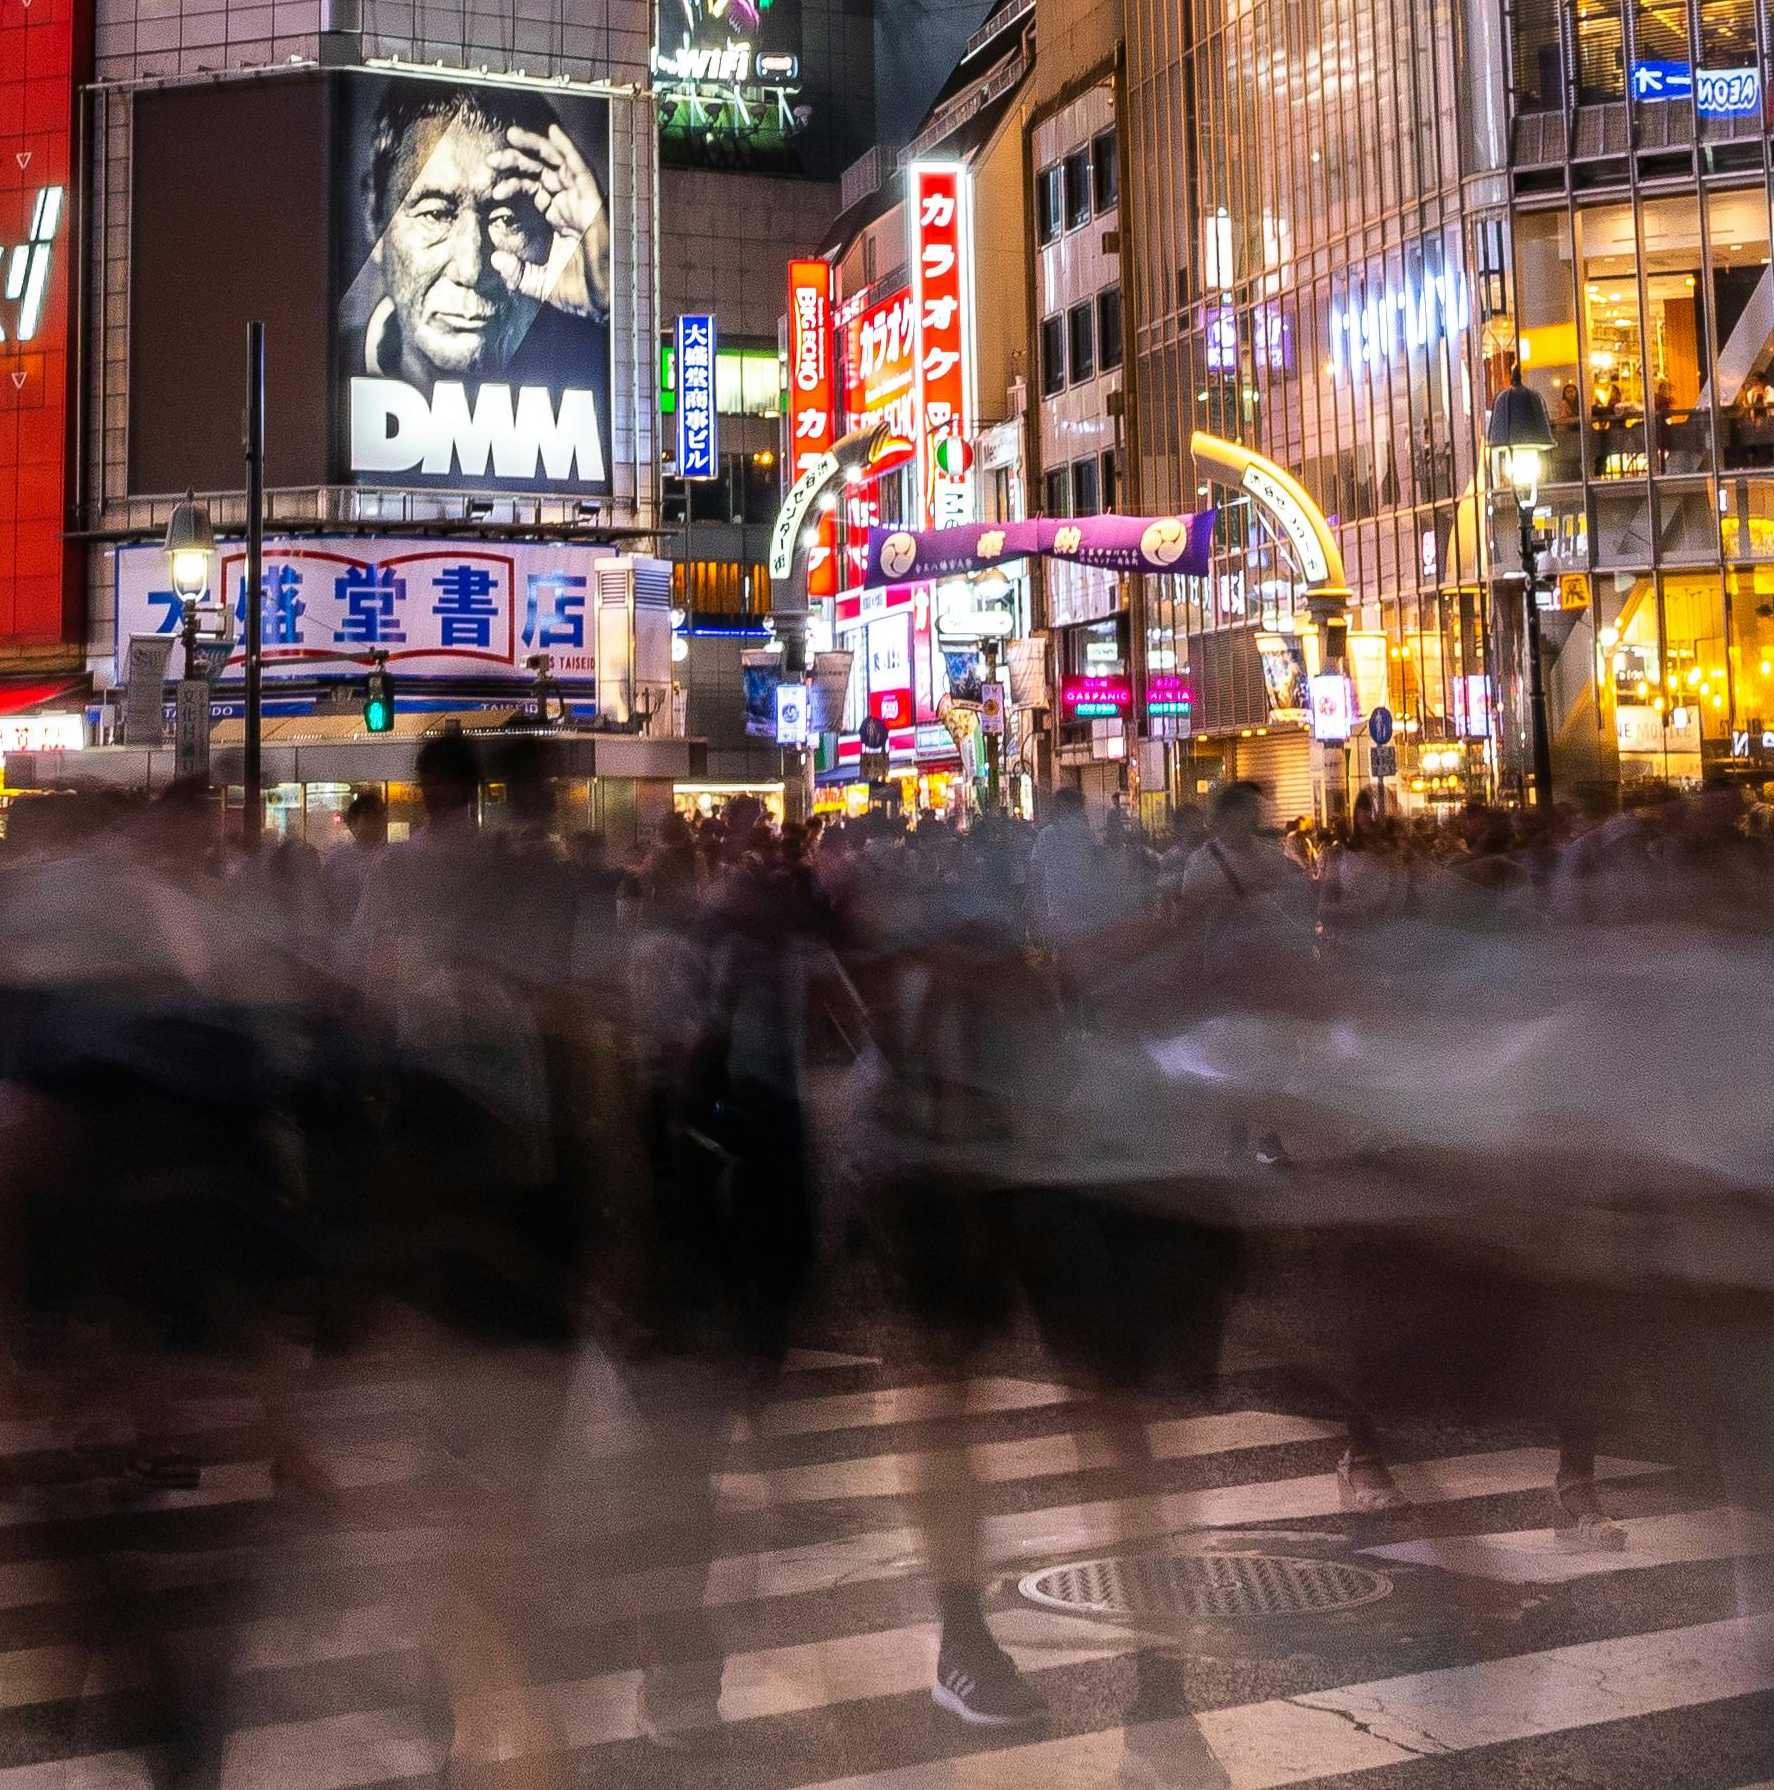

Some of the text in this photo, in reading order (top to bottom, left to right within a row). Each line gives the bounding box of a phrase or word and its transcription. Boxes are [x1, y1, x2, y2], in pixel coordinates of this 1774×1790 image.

[921, 192, 960, 382] カラオケ
[348, 376, 606, 481] DMM
[683, 323, 710, 471] 大盛堂商事ビル
[773, 459, 830, 572] 渋谷センター街
[146, 562, 588, 649] 大盛堂書店
[1066, 691, 1130, 701] GASPANIC
